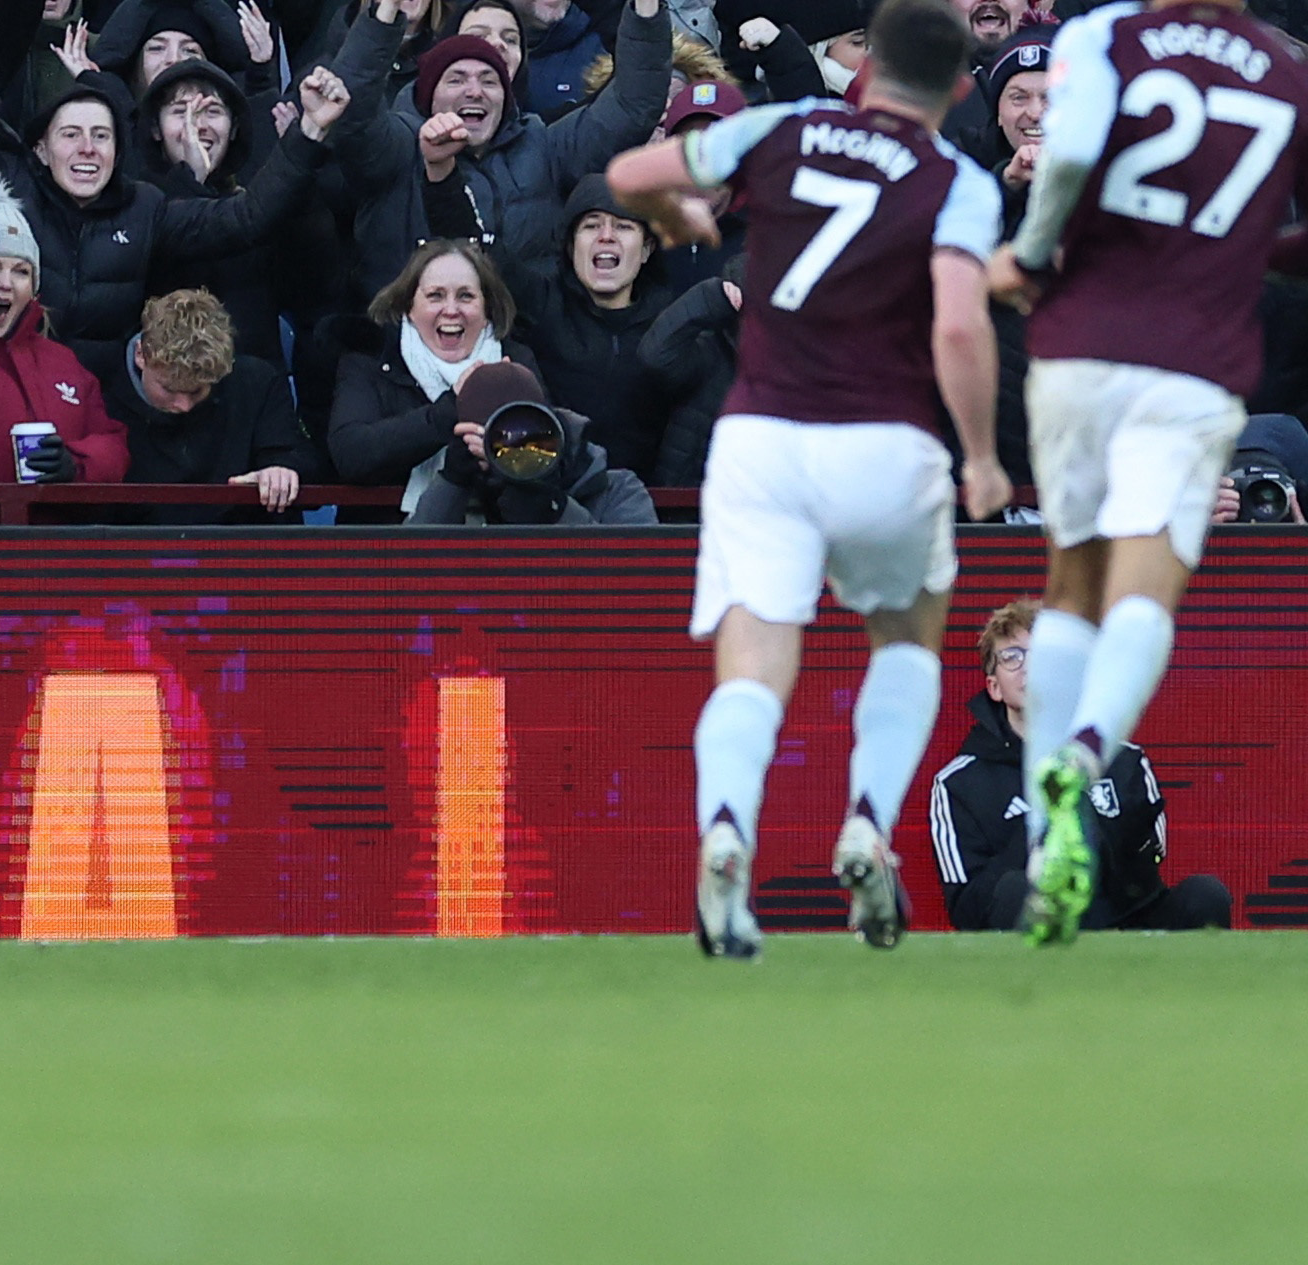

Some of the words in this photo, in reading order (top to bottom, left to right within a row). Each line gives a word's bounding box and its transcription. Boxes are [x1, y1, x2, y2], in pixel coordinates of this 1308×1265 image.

[1140, 22, 1272, 84] ROGERS
[1098, 68, 1298, 239] 27
[769, 165, 883, 312] 7
